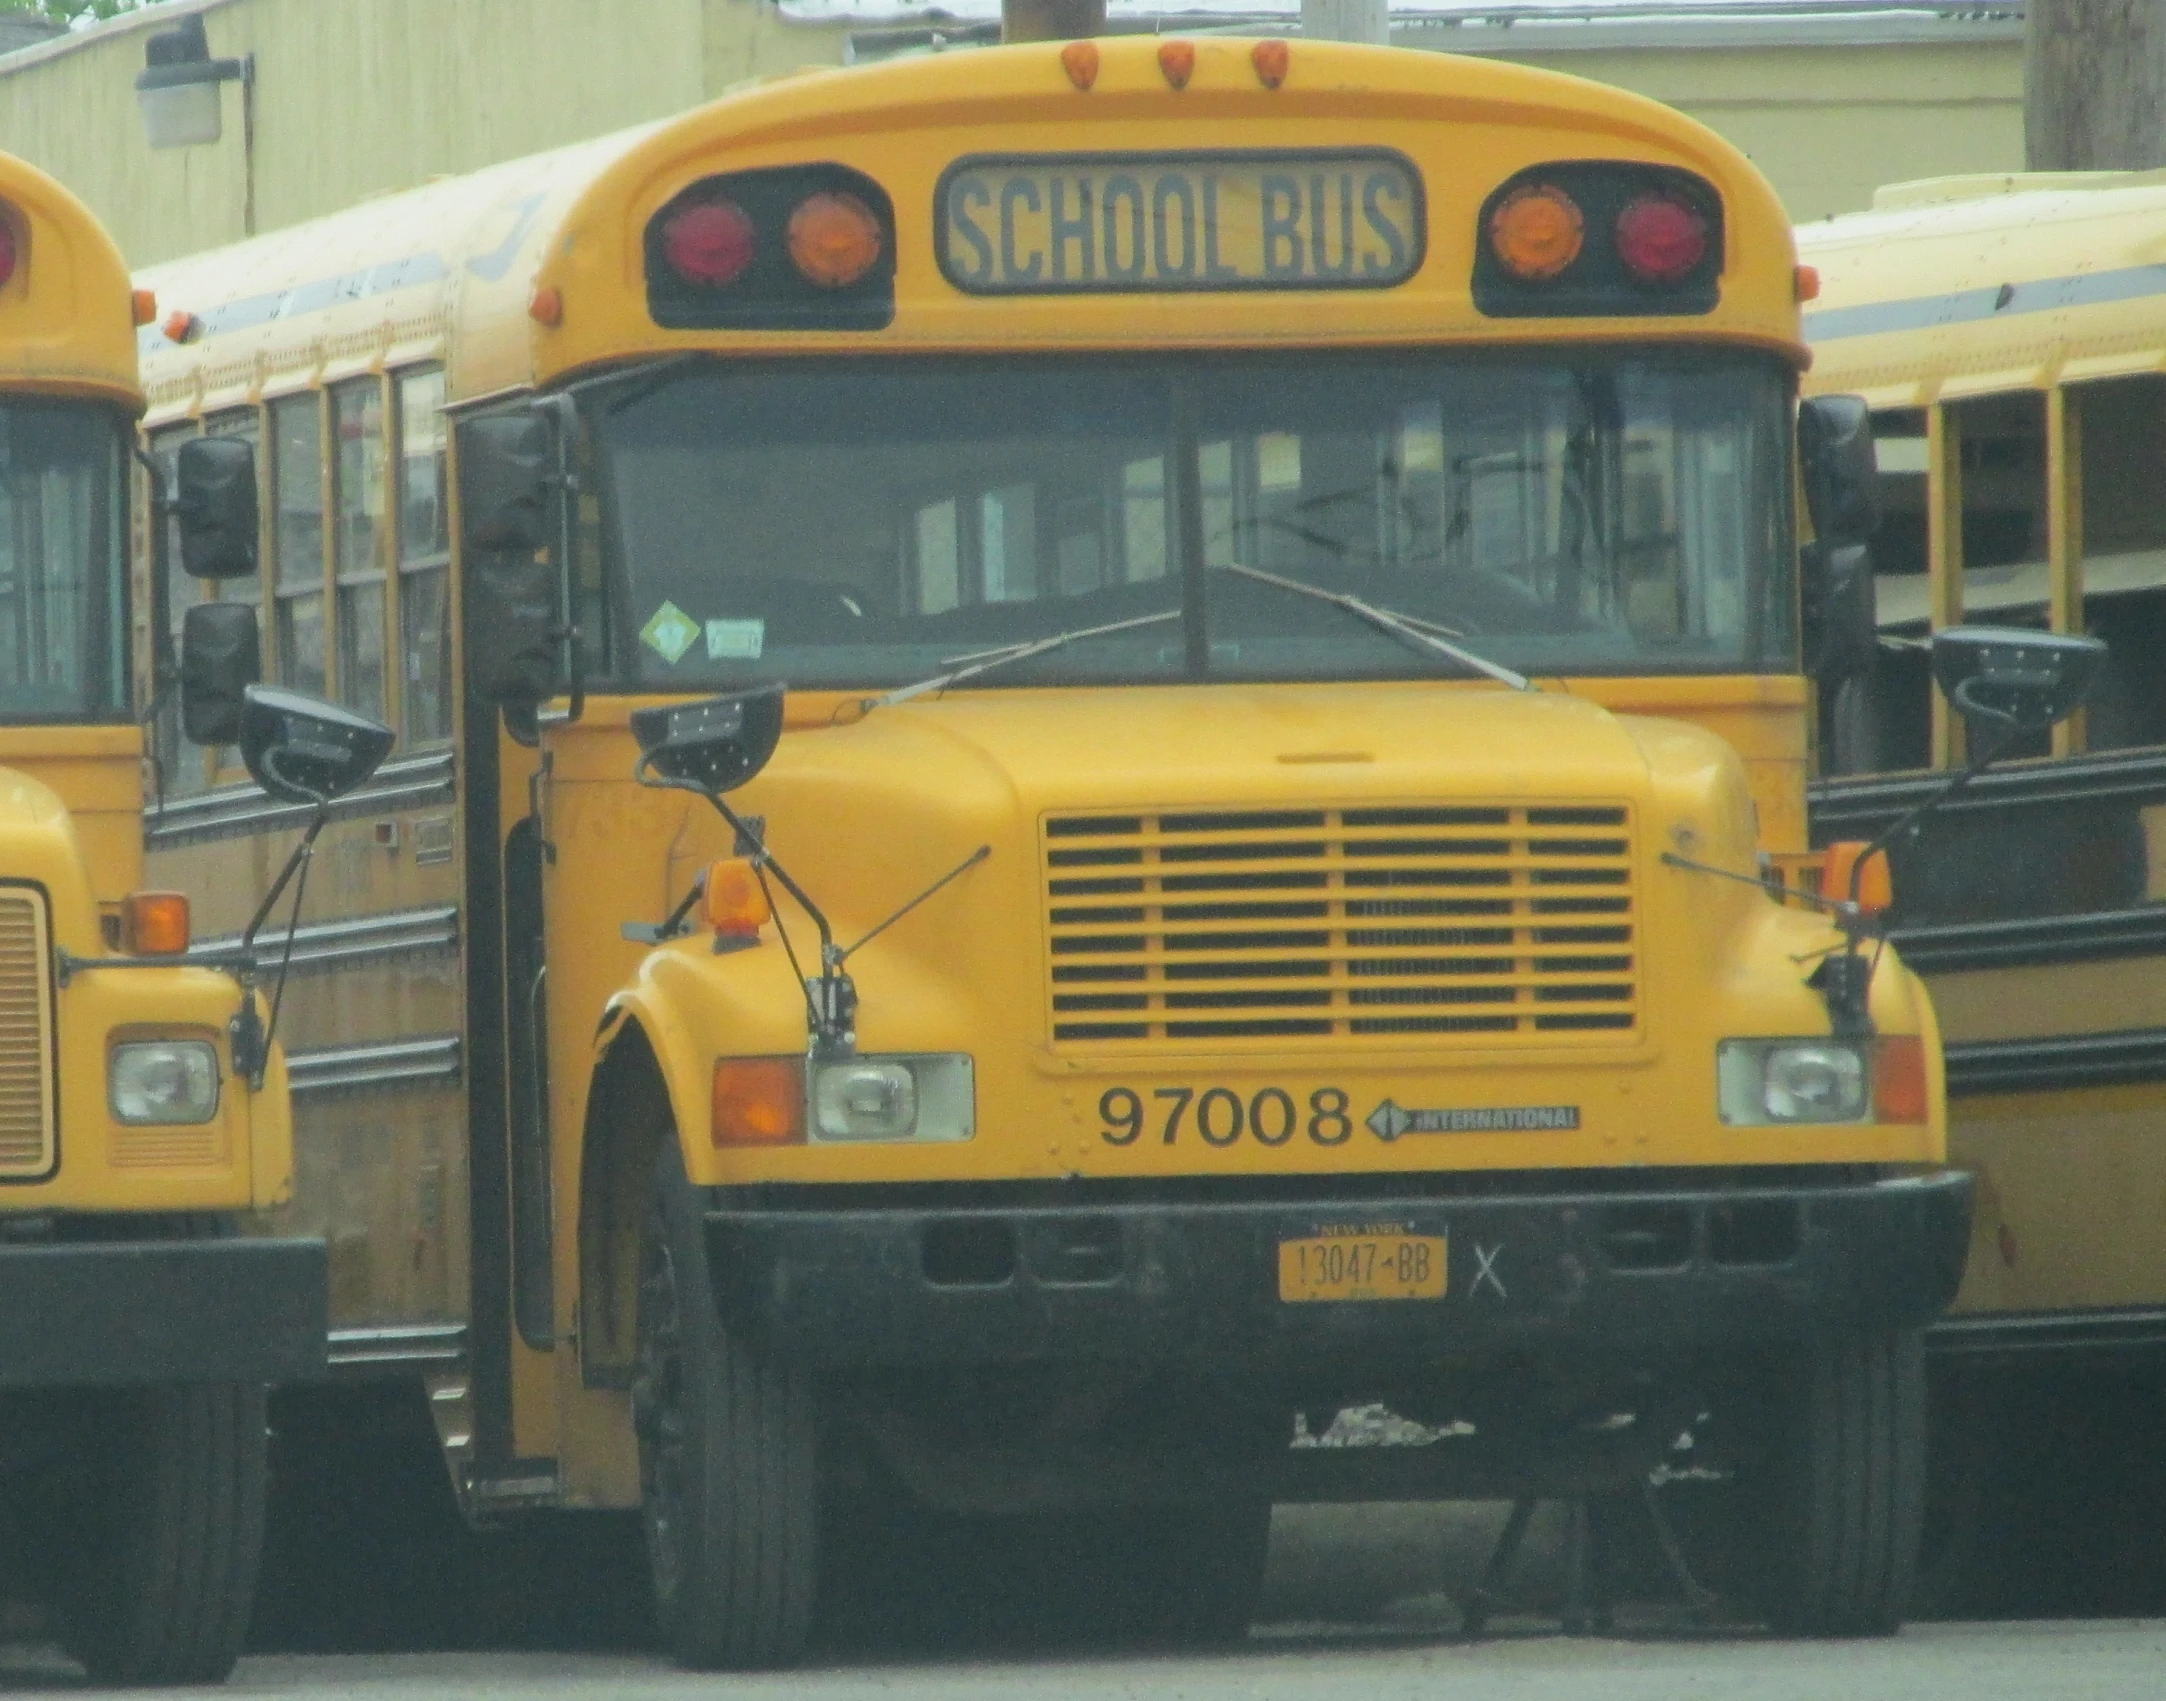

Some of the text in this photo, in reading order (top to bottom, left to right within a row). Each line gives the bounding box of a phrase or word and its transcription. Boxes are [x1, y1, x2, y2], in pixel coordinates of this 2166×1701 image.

[949, 173, 1407, 285] SCHOOL BUS
[1100, 1087, 1352, 1146] 97008
[1411, 1107, 1577, 1132] INTERNATIONAL
[1468, 1243, 1507, 1298] X
